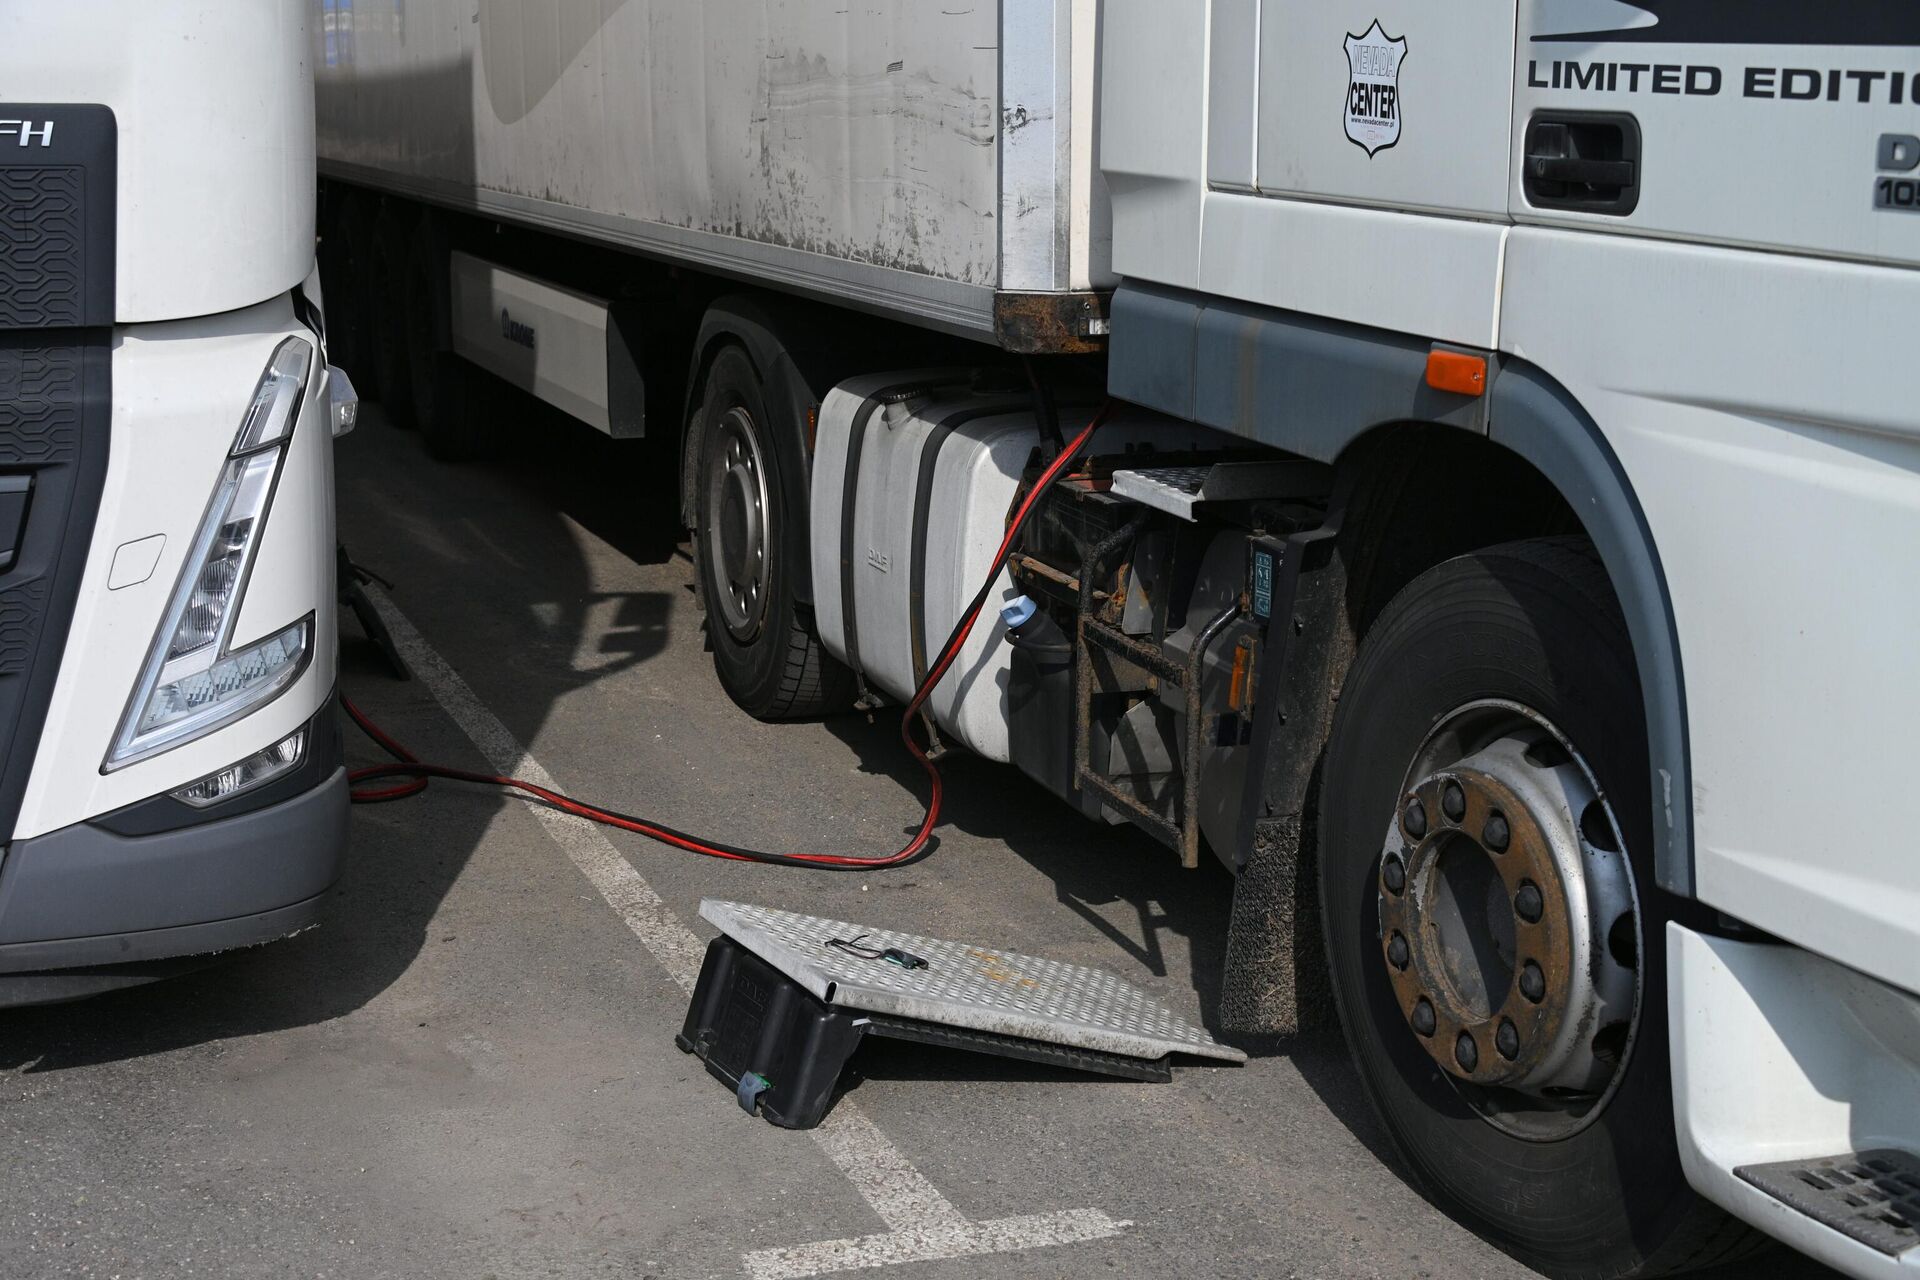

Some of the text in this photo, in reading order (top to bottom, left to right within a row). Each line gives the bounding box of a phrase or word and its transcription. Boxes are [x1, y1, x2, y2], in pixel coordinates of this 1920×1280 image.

[1353, 44, 1395, 78] NEVADA
[1528, 60, 1920, 105] LIMITED EDITI
[1350, 81, 1395, 119] CENTER
[1350, 117, 1395, 129] www.nevadacenter.pl
[1879, 179, 1920, 207] 10
